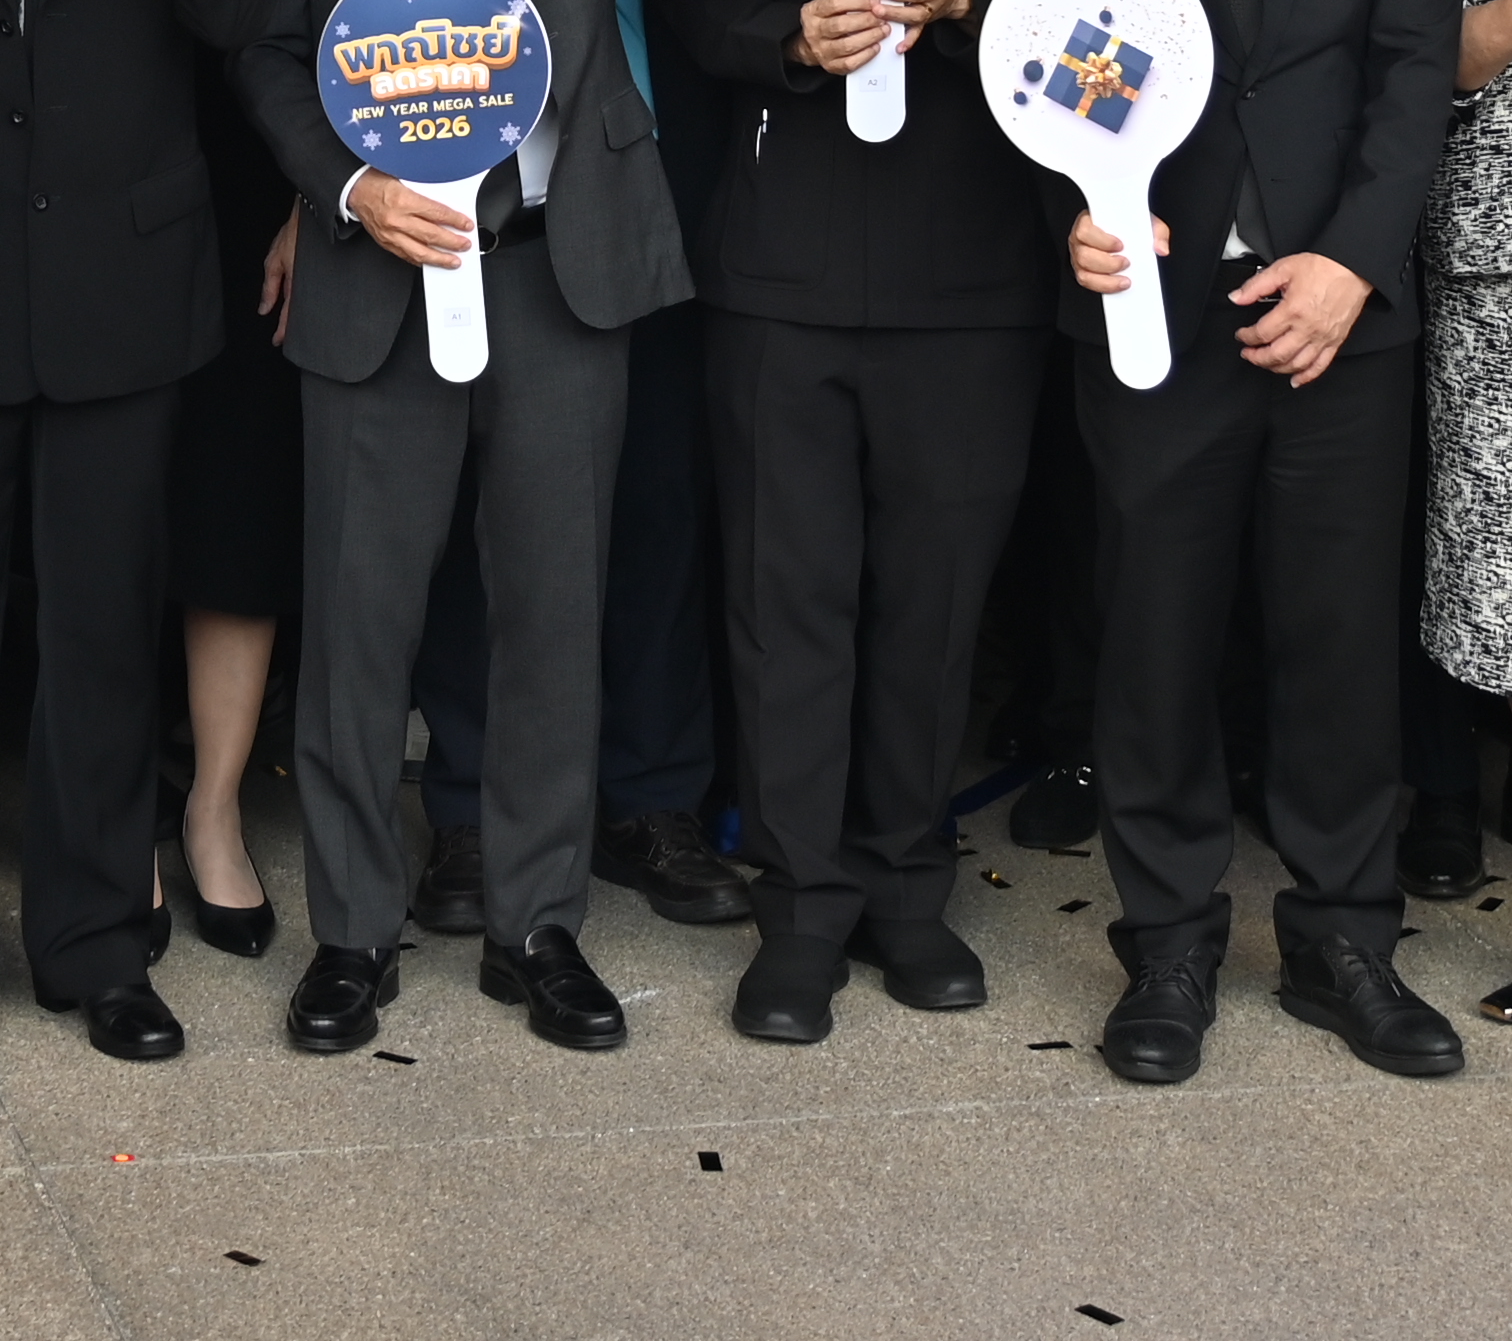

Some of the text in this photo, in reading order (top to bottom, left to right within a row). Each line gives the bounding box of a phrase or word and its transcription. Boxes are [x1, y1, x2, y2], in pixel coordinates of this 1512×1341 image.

[338, 20, 515, 81] พาณิชย์
[370, 64, 489, 96] ลดราคา
[351, 92, 515, 121] NEW YEAR MEGA SALE
[398, 116, 472, 144] 2026
